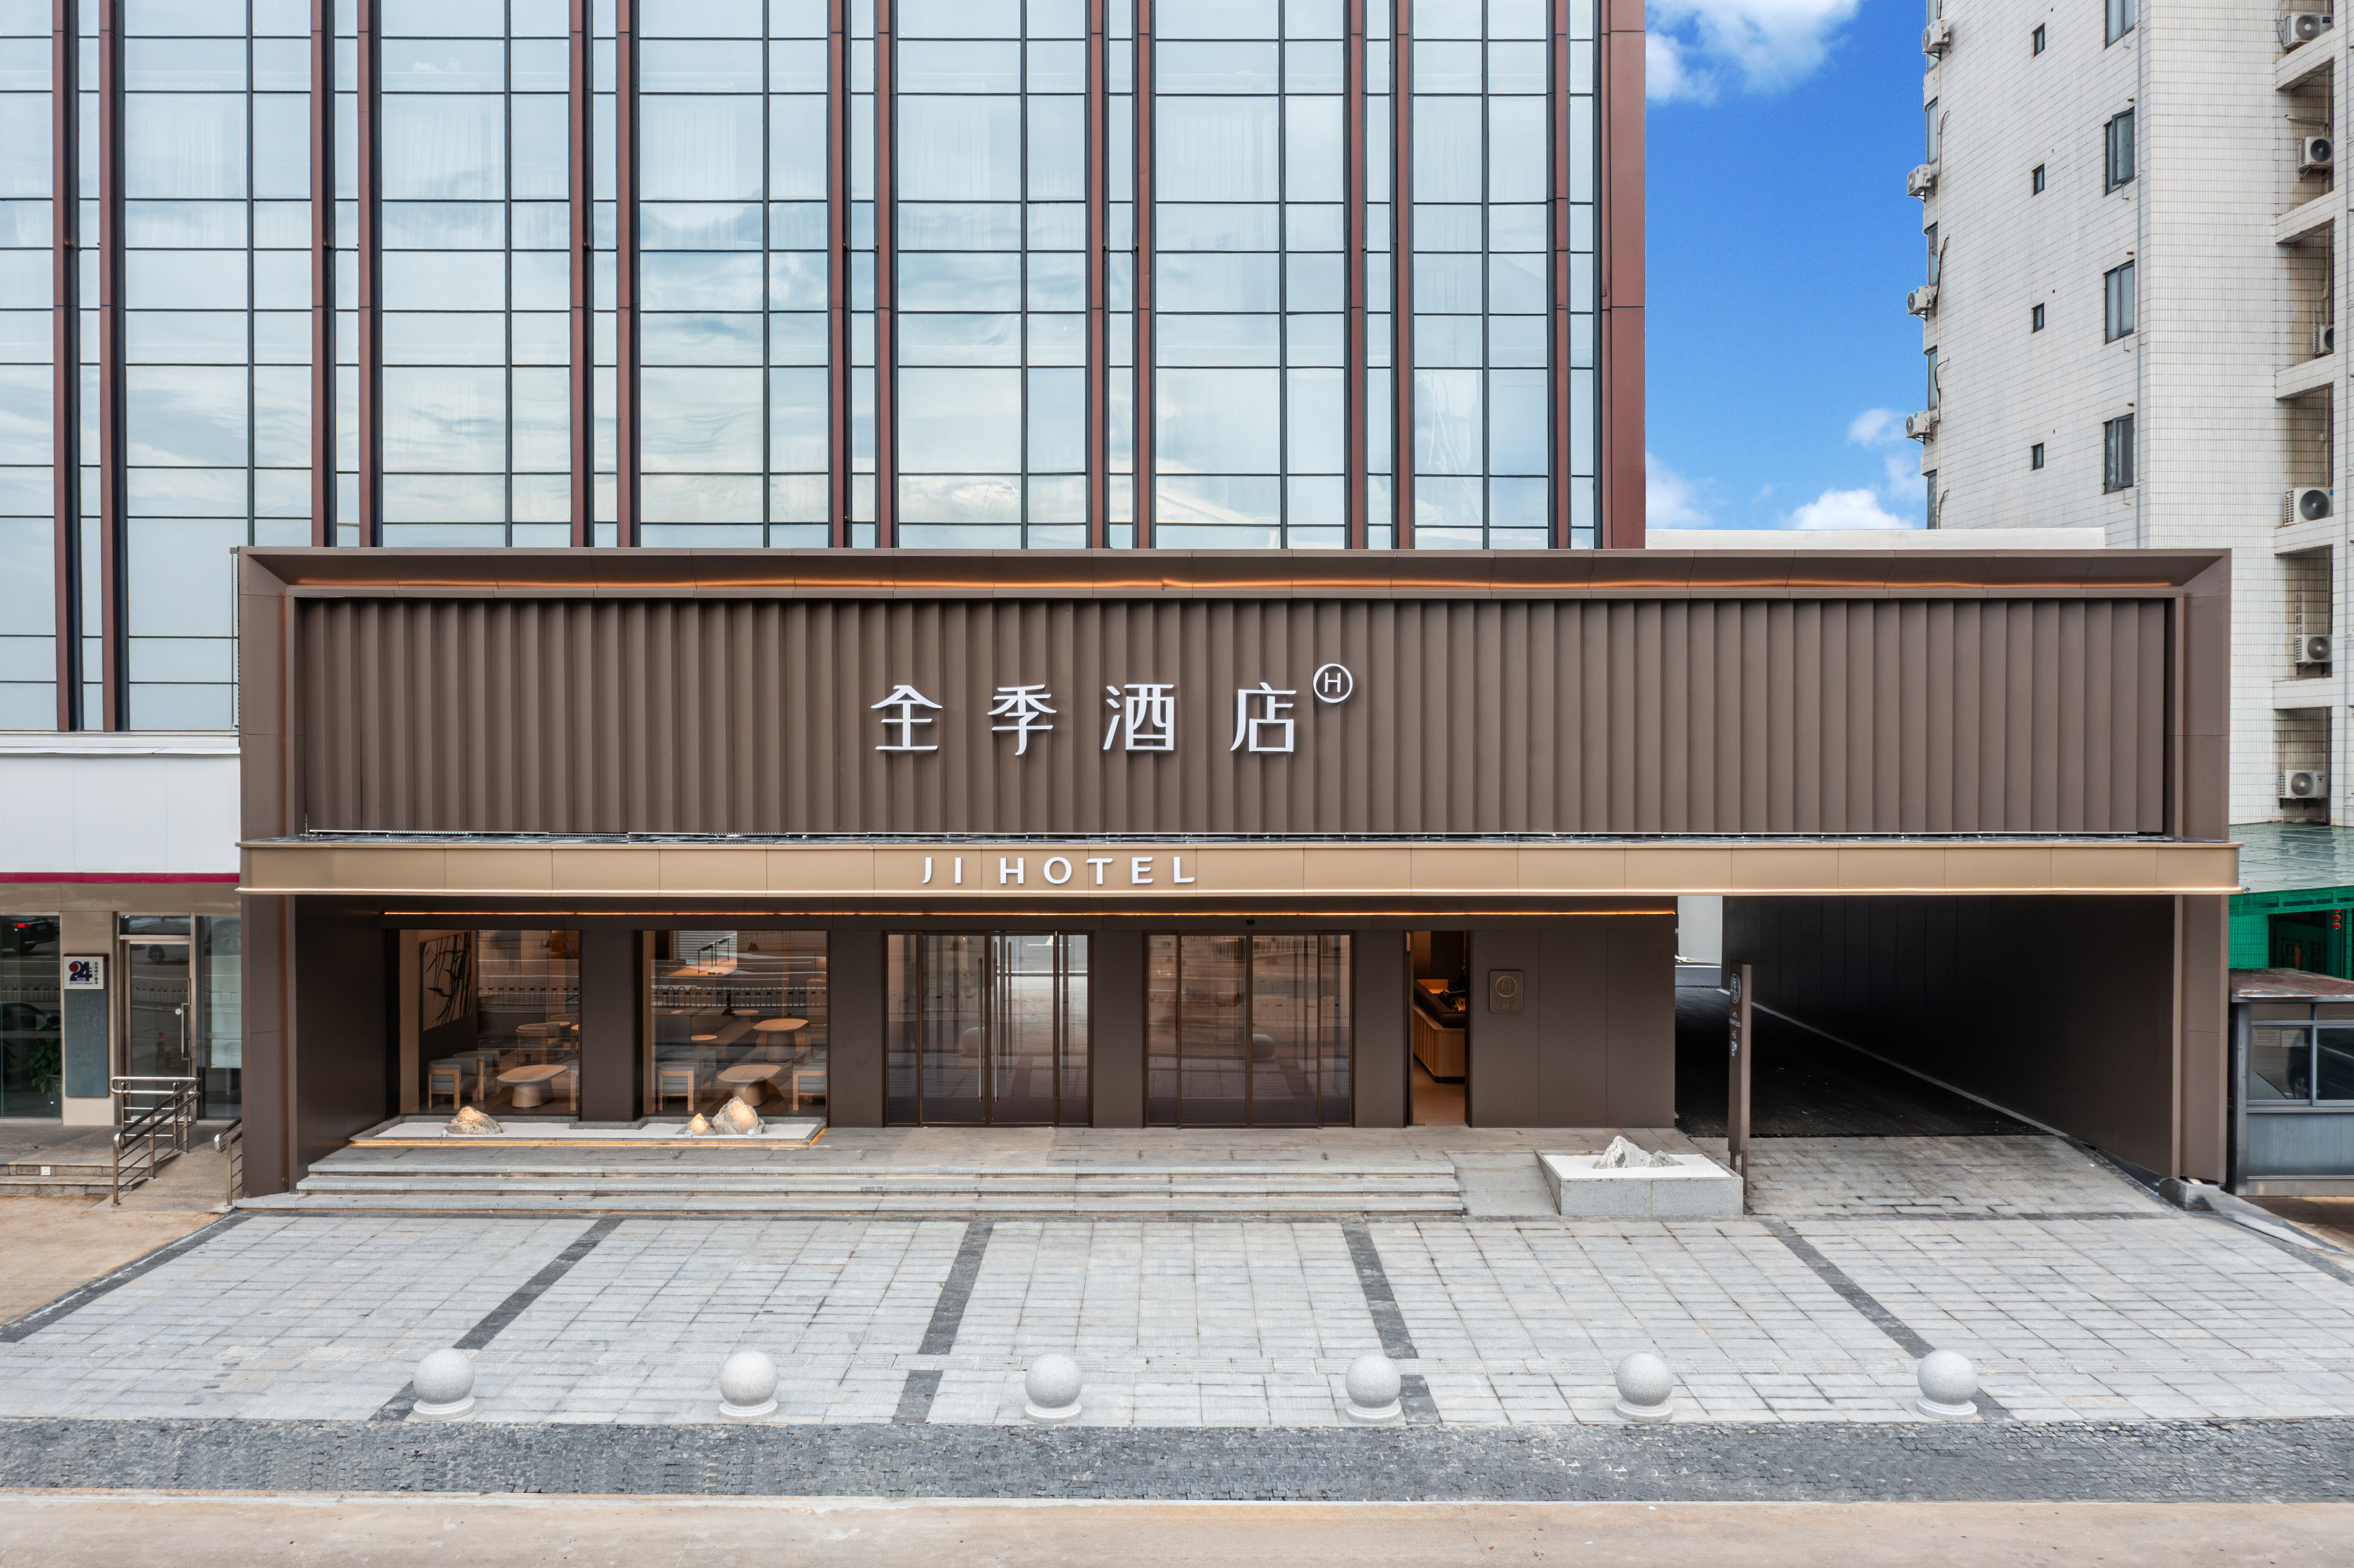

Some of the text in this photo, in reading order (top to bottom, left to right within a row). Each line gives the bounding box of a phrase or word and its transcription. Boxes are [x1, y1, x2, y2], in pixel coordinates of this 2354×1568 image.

[871, 682, 1297, 756] 全季酒店
[922, 856, 1195, 885] JI HOTEL
[69, 961, 93, 981] 24
